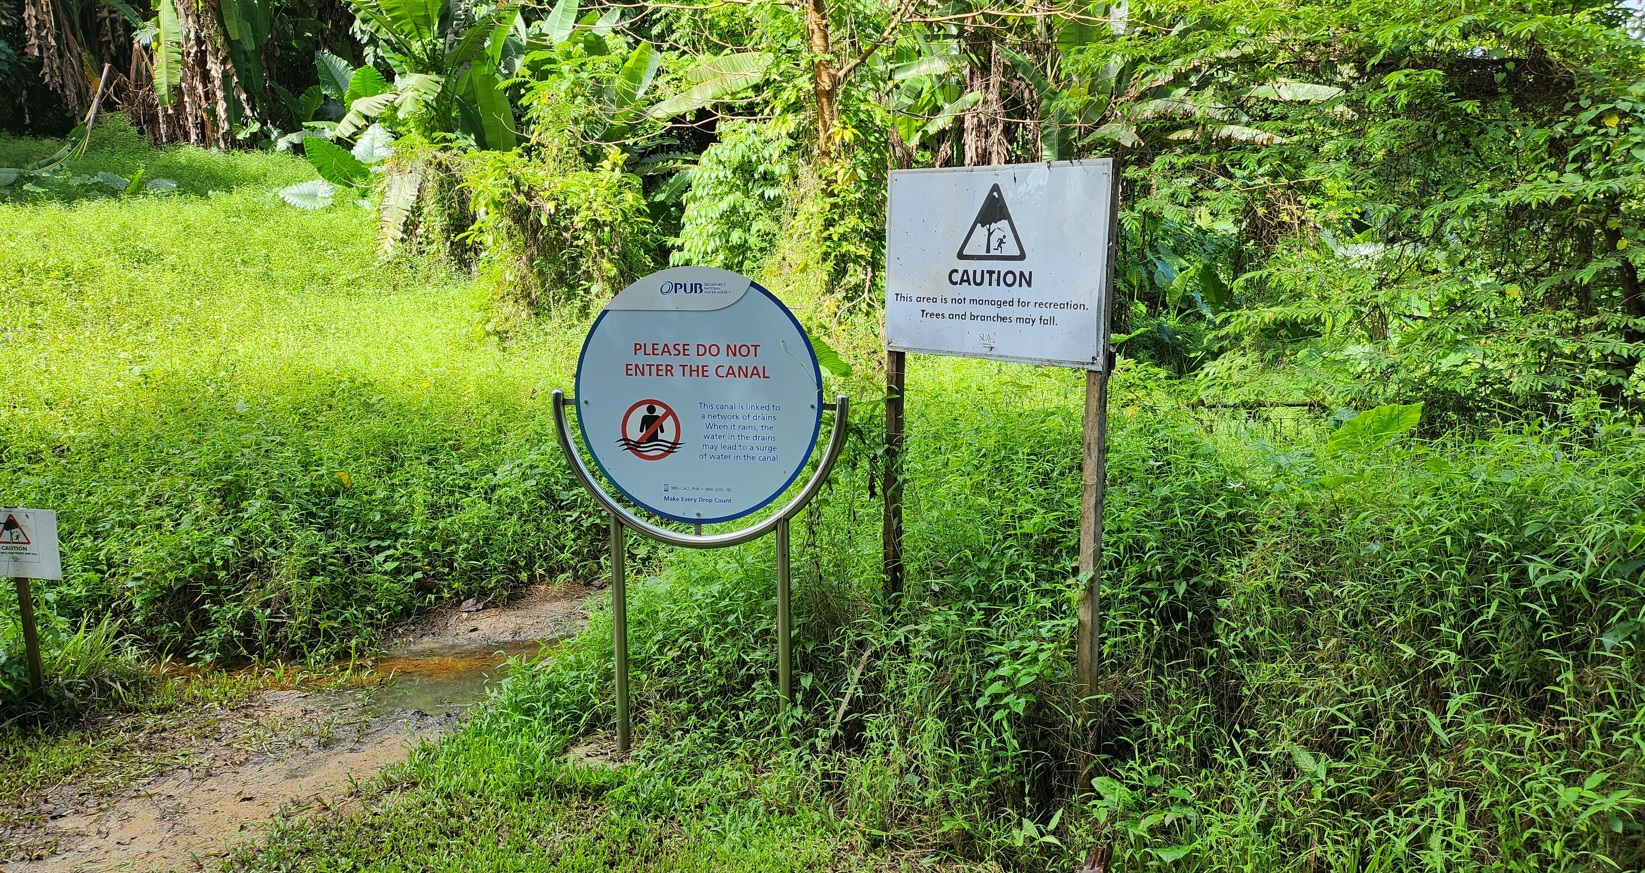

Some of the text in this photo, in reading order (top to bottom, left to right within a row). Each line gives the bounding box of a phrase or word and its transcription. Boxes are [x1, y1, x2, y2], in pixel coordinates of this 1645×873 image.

[948, 268, 1033, 288] CAUTION
[674, 283, 703, 294] PUB
[895, 293, 913, 303] This
[941, 295, 948, 304] is
[951, 297, 966, 305] not
[969, 298, 1014, 308] managed
[1017, 298, 1031, 308] for
[1034, 301, 1088, 311] recreation.
[921, 310, 1058, 327] Trees and branches may fall.
[633, 342, 760, 358] PLEASE DO NOT
[625, 364, 770, 379] ENTER THE CANAL
[738, 424, 758, 432] rains,
[702, 443, 718, 452] may
[756, 444, 778, 453] surge
[757, 454, 780, 462] canal.
